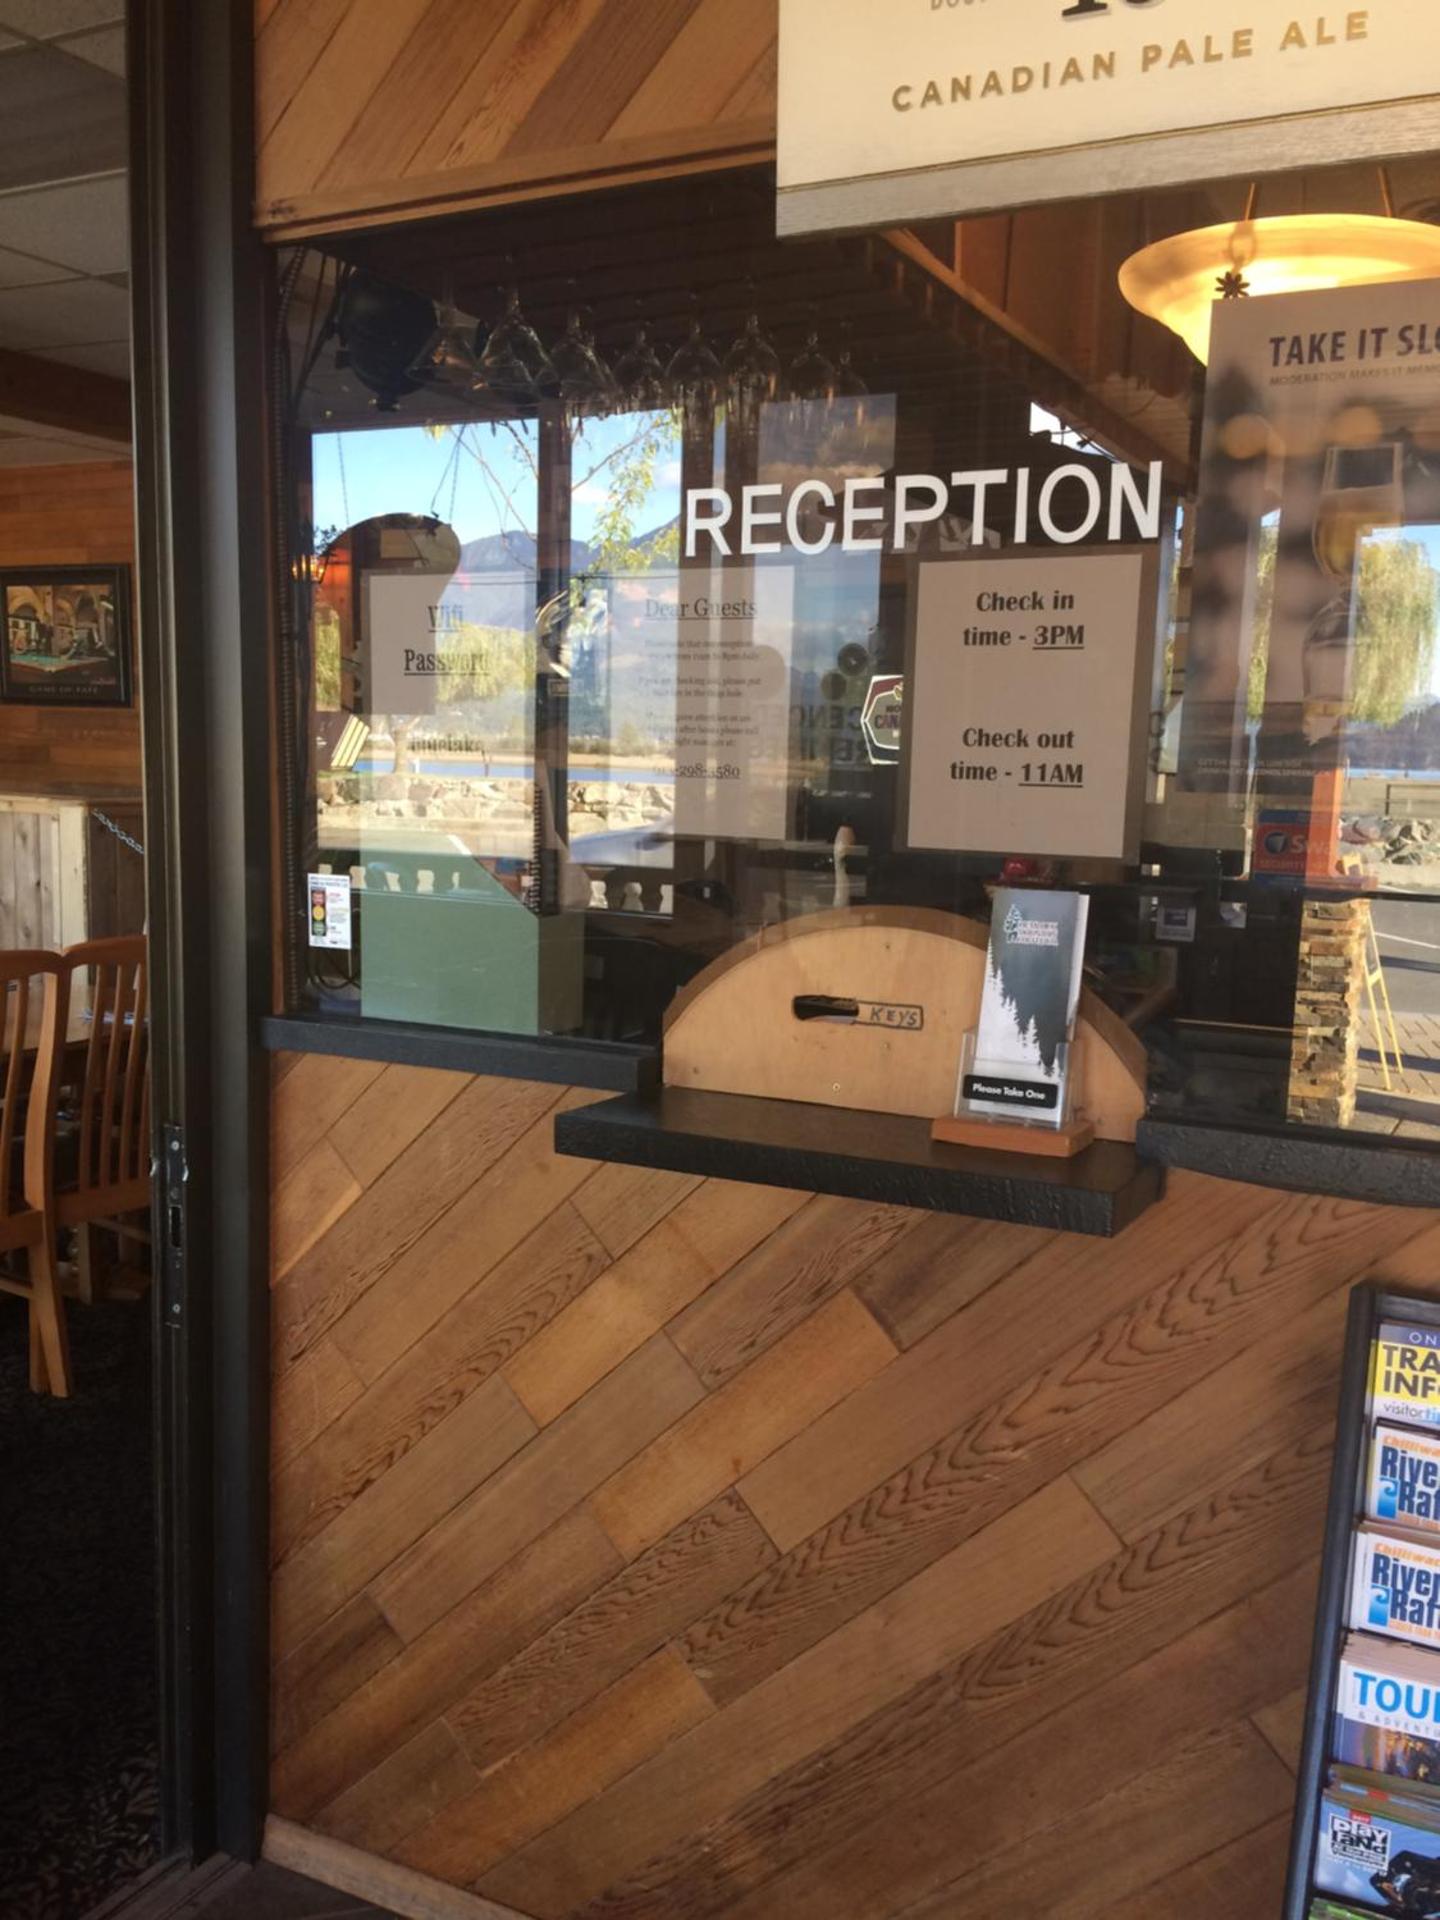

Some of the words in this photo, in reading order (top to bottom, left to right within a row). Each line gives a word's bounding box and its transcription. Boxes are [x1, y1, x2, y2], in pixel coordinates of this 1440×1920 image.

[892, 51, 1115, 112] CANADIAN
[1141, 28, 1253, 72] PALE
[1279, 10, 1368, 51] ALE
[1269, 331, 1346, 367] TAKE
[1358, 327, 1388, 360] IT
[685, 461, 1162, 557] RECEPTION
[645, 598, 688, 616] Dear
[694, 598, 758, 616] Guests
[976, 591, 1044, 611] Check
[1053, 590, 1075, 610] in
[963, 627, 1011, 646] time
[1034, 625, 1084, 648] 3PM
[963, 728, 1029, 748] Check
[1037, 731, 1074, 748] out
[950, 761, 997, 781] time
[1020, 763, 1083, 787] 11AM
[870, 1006, 918, 1026] KEYS
[972, 1083, 1002, 1095] Please
[1003, 1086, 1024, 1098] Take
[1025, 1089, 1046, 1100] One
[1390, 1588, 1440, 1629] Raf
